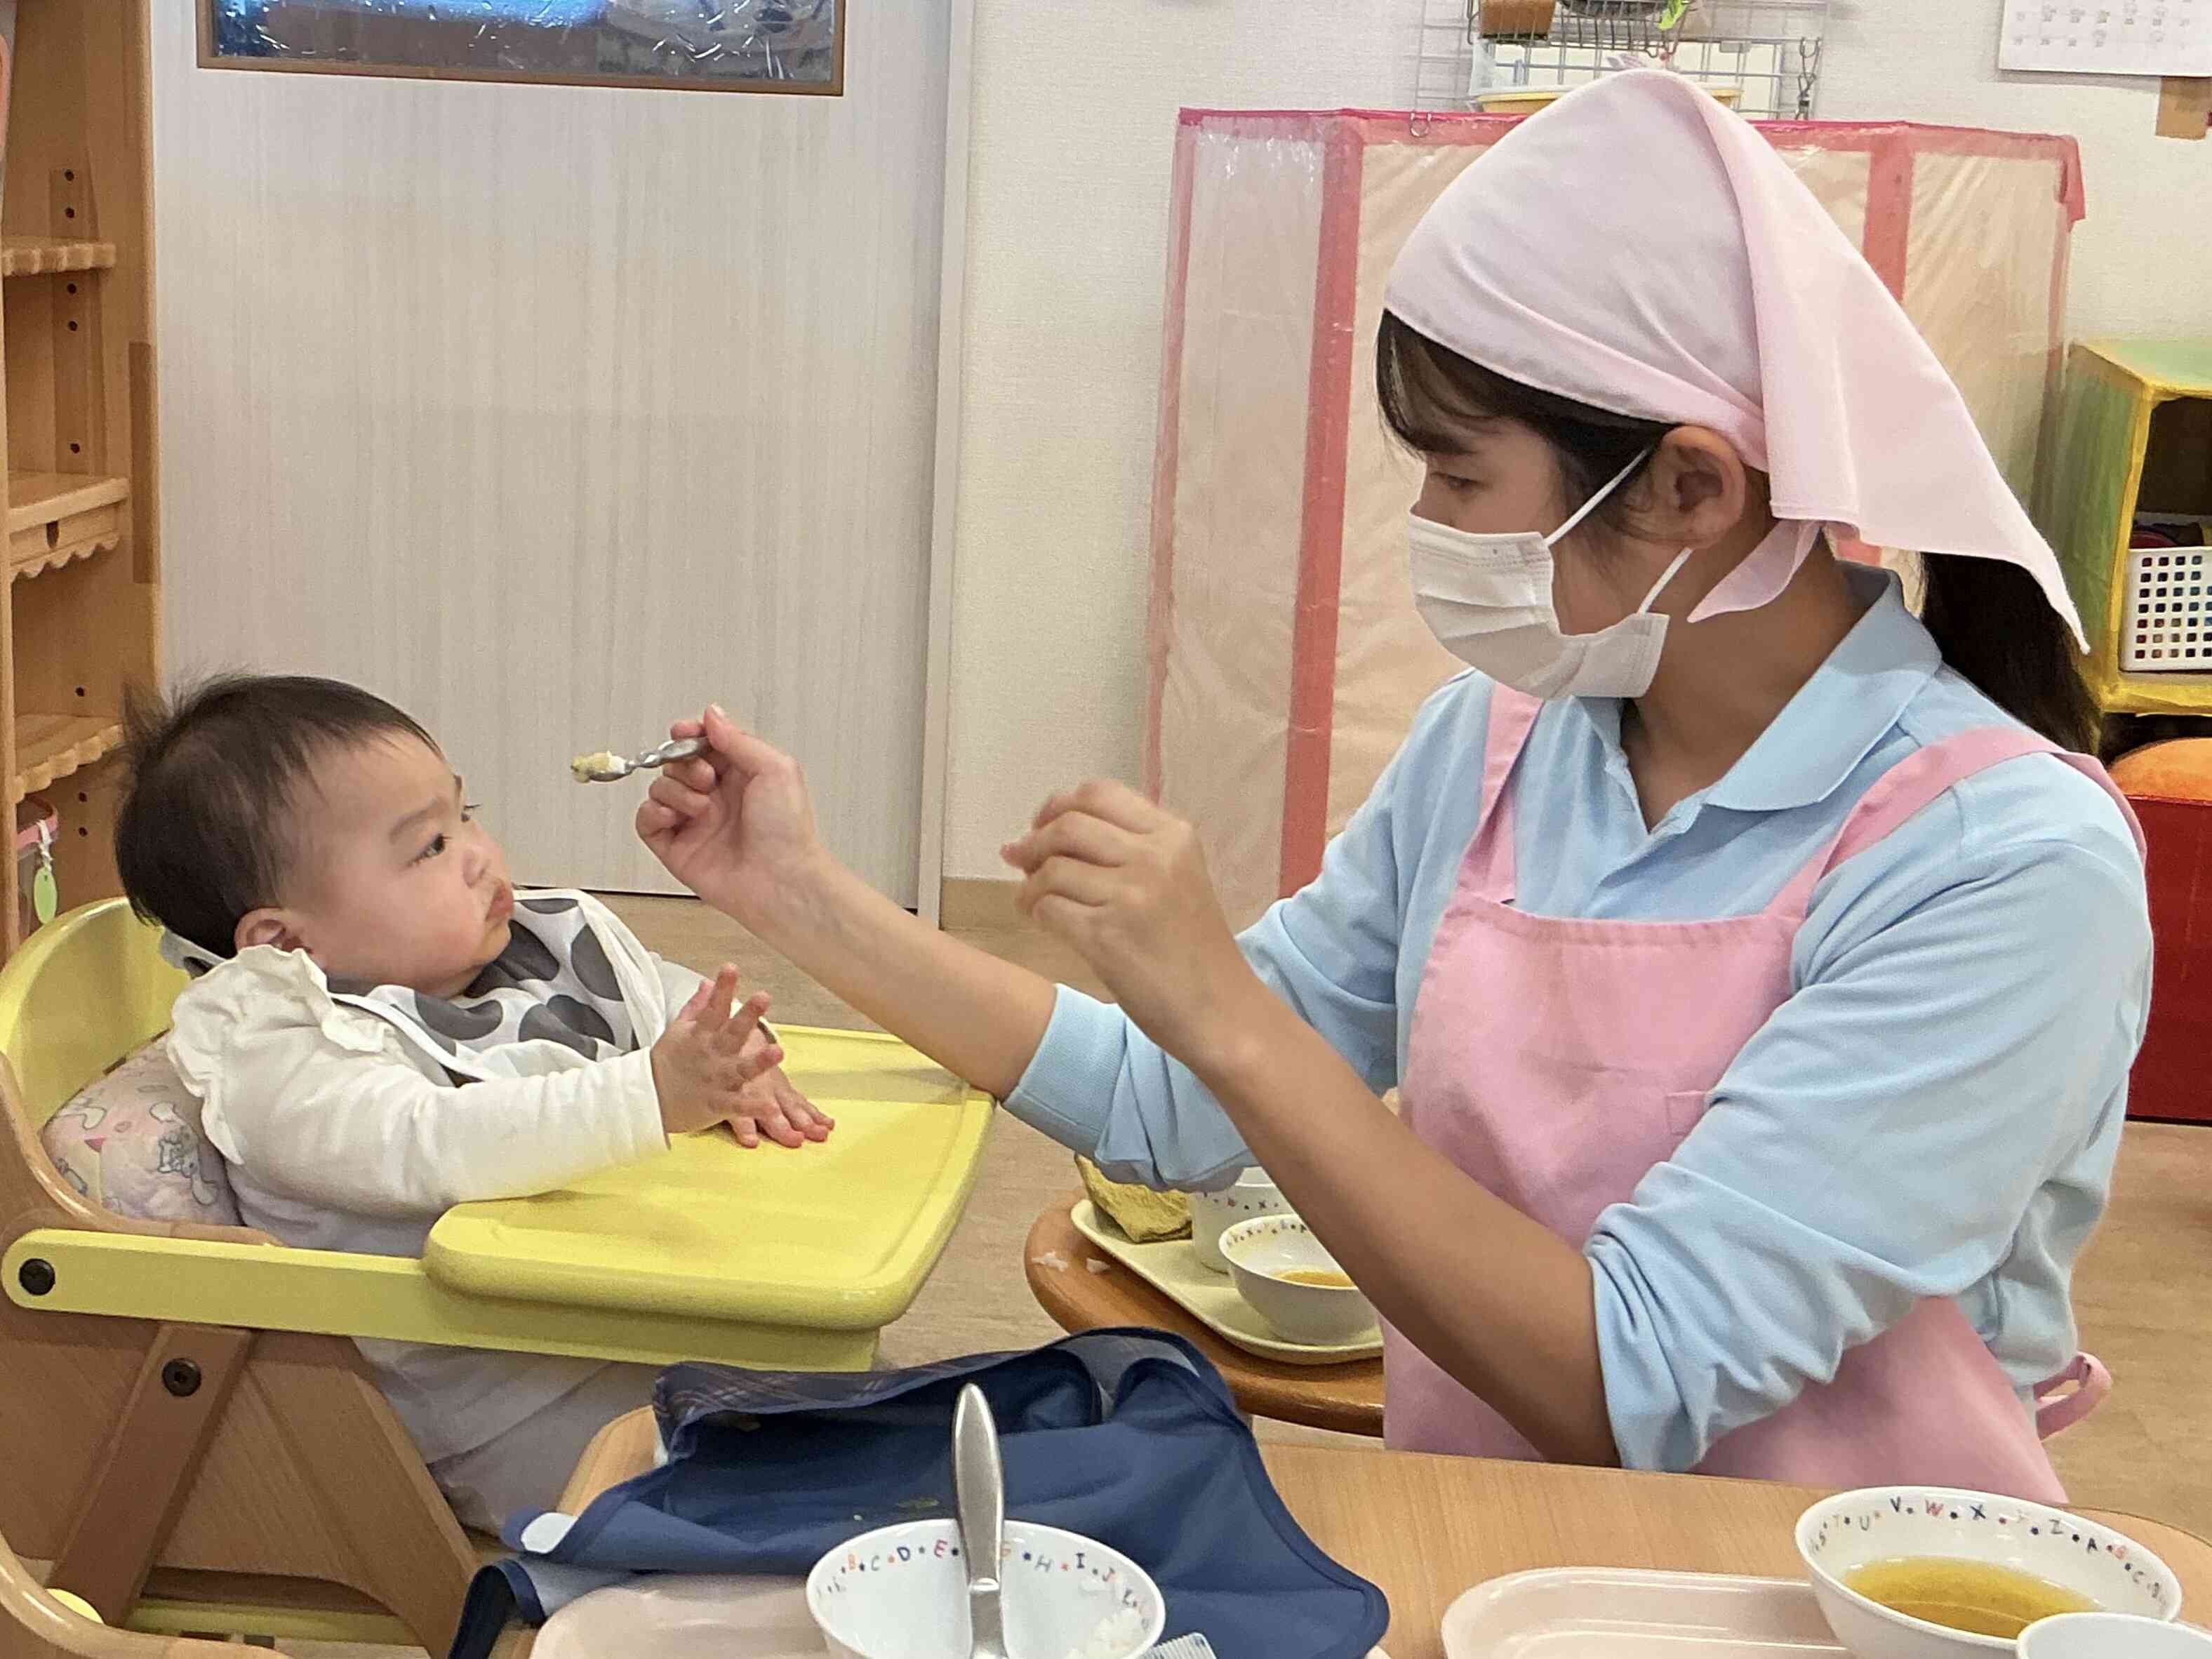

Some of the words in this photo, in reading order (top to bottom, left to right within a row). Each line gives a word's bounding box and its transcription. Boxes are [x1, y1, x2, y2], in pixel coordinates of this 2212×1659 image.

[1858, 1514, 1870, 1531] U
[1889, 1495, 1902, 1513] V
[1924, 1498, 1944, 1517] W
[1969, 1503, 1987, 1520] X
[2048, 1518, 2065, 1535] Z
[2086, 1537, 2099, 1554] A
[870, 1554, 880, 1571] C
[896, 1545, 911, 1561] D
[934, 1539, 949, 1558] E
[1034, 1554, 1055, 1573] H
[1074, 1552, 1087, 1570] I
[1102, 1566, 1115, 1582] J
